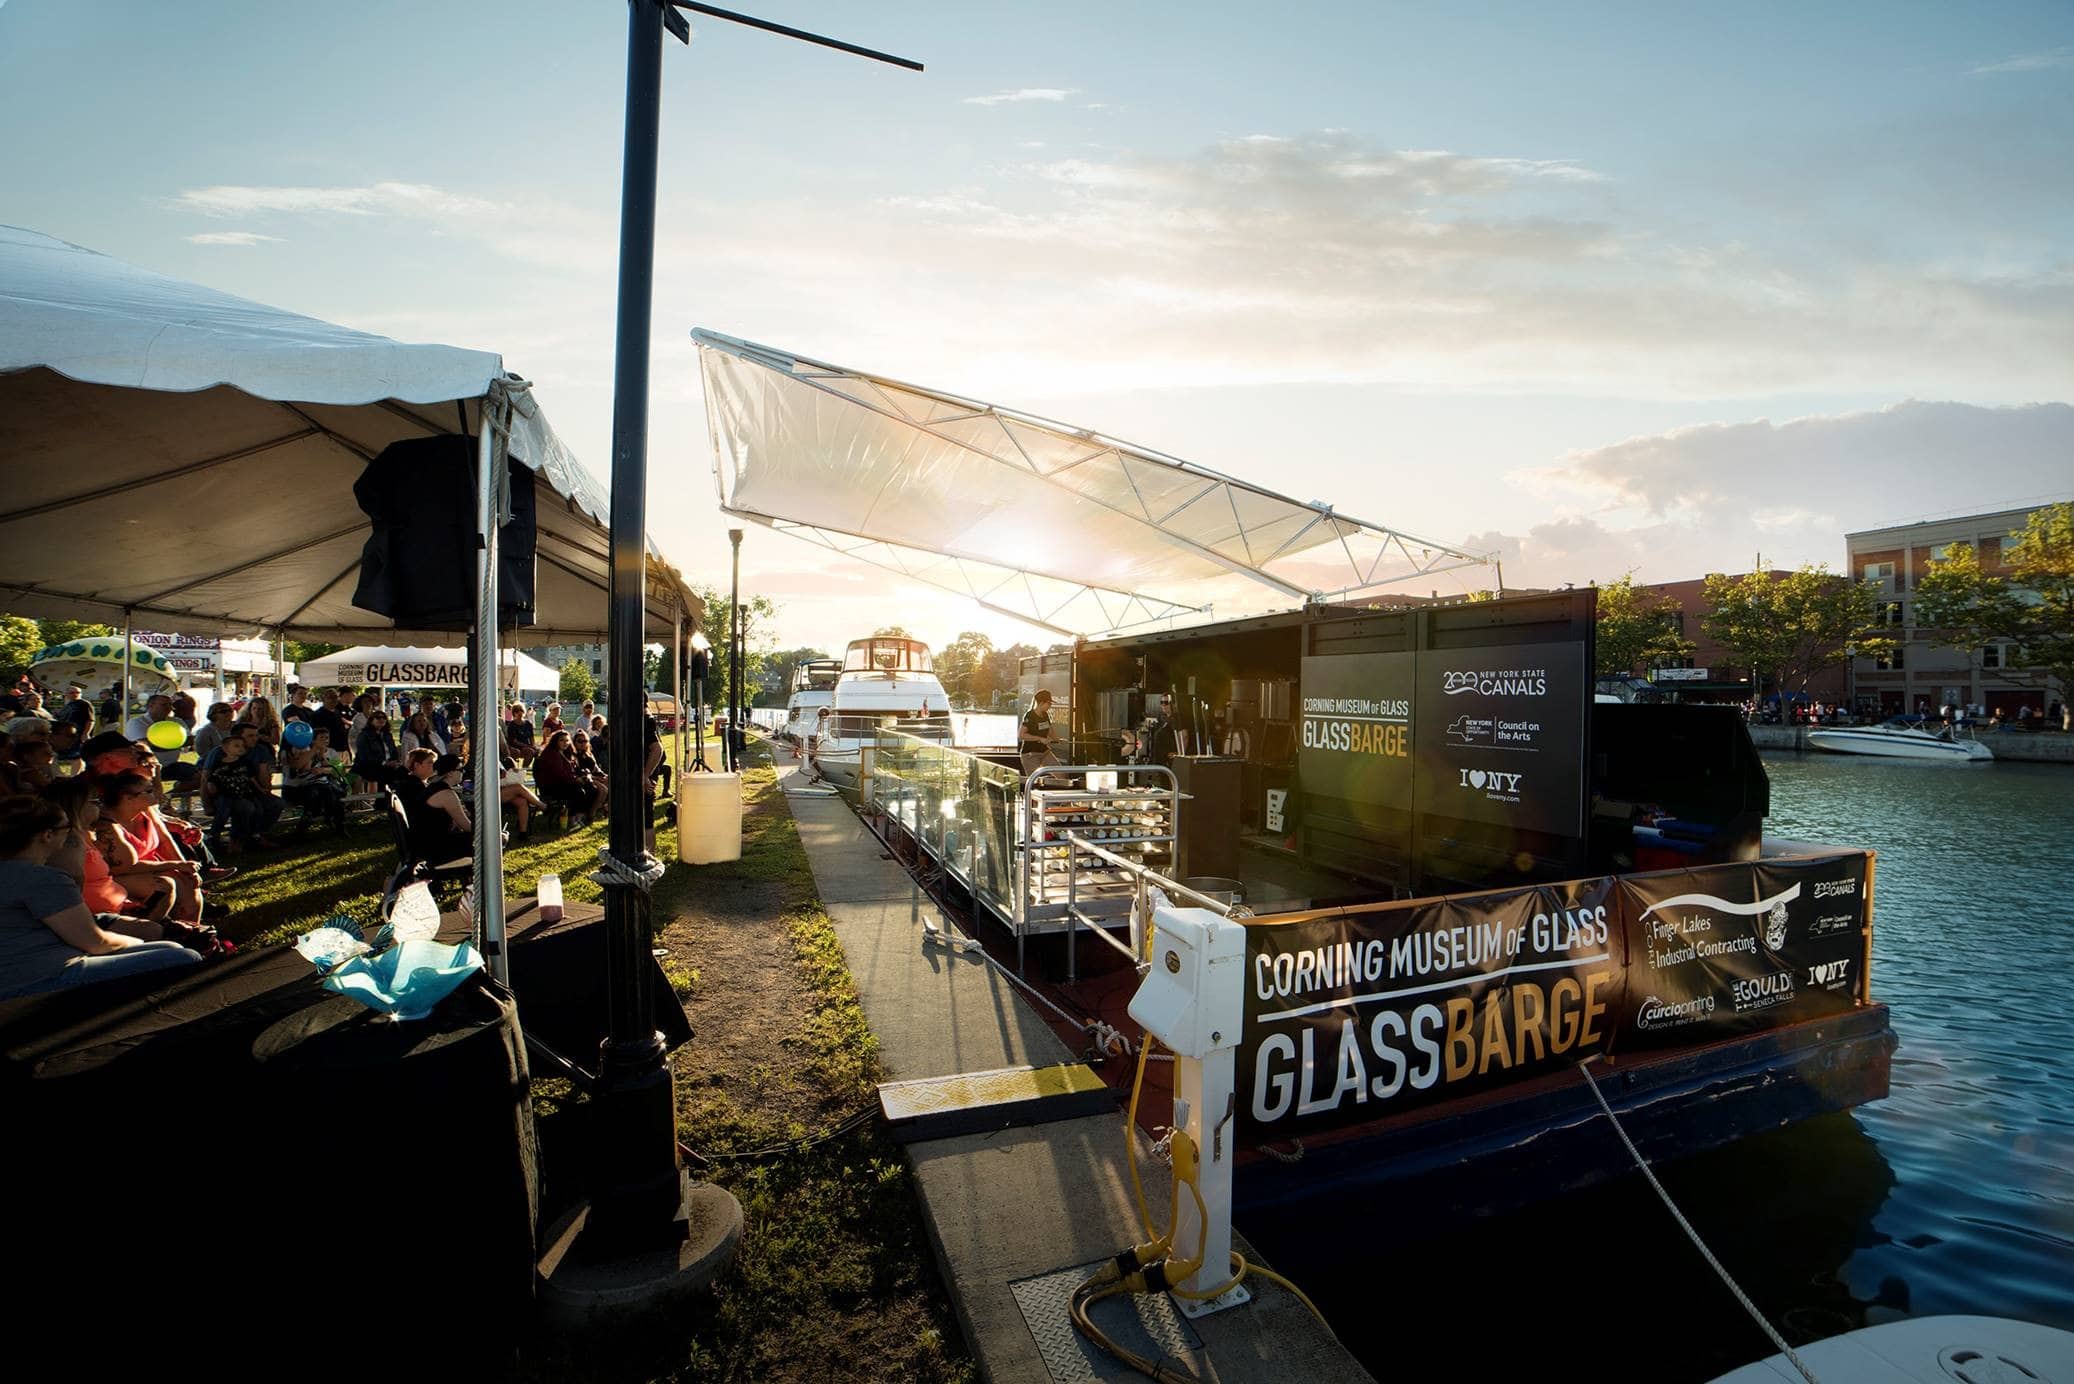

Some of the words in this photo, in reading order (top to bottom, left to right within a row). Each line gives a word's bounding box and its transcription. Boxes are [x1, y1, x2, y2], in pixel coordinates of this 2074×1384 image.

[133, 635, 171, 645] ONION
[176, 636, 211, 645] RINGS
[366, 663, 469, 684] GLASSBARG
[1480, 671, 1496, 679] NEW
[1498, 670, 1519, 678] YORK
[1522, 669, 1545, 678] STATE
[1480, 679, 1546, 696] CANALS
[1303, 698, 1335, 713] CORNING
[1336, 699, 1370, 714] MUSEUM
[1380, 700, 1409, 716] GLASS
[1498, 721, 1527, 731] Council
[1498, 732, 1510, 740] the
[1512, 732, 1531, 741] Arts
[1303, 720, 1408, 757] GLASSBARGE
[1653, 920, 1680, 942] Finger
[1682, 915, 1712, 933] Lakes
[1255, 938, 1384, 1000] CORNING
[1390, 921, 1502, 978] MUSEUM
[1532, 905, 1609, 953] GLASS
[1656, 942, 1696, 968] Industrial
[1696, 934, 1757, 957] Contracting
[1740, 973, 1790, 1001] GOULD
[1252, 971, 1611, 1123] GLASSBARGE
